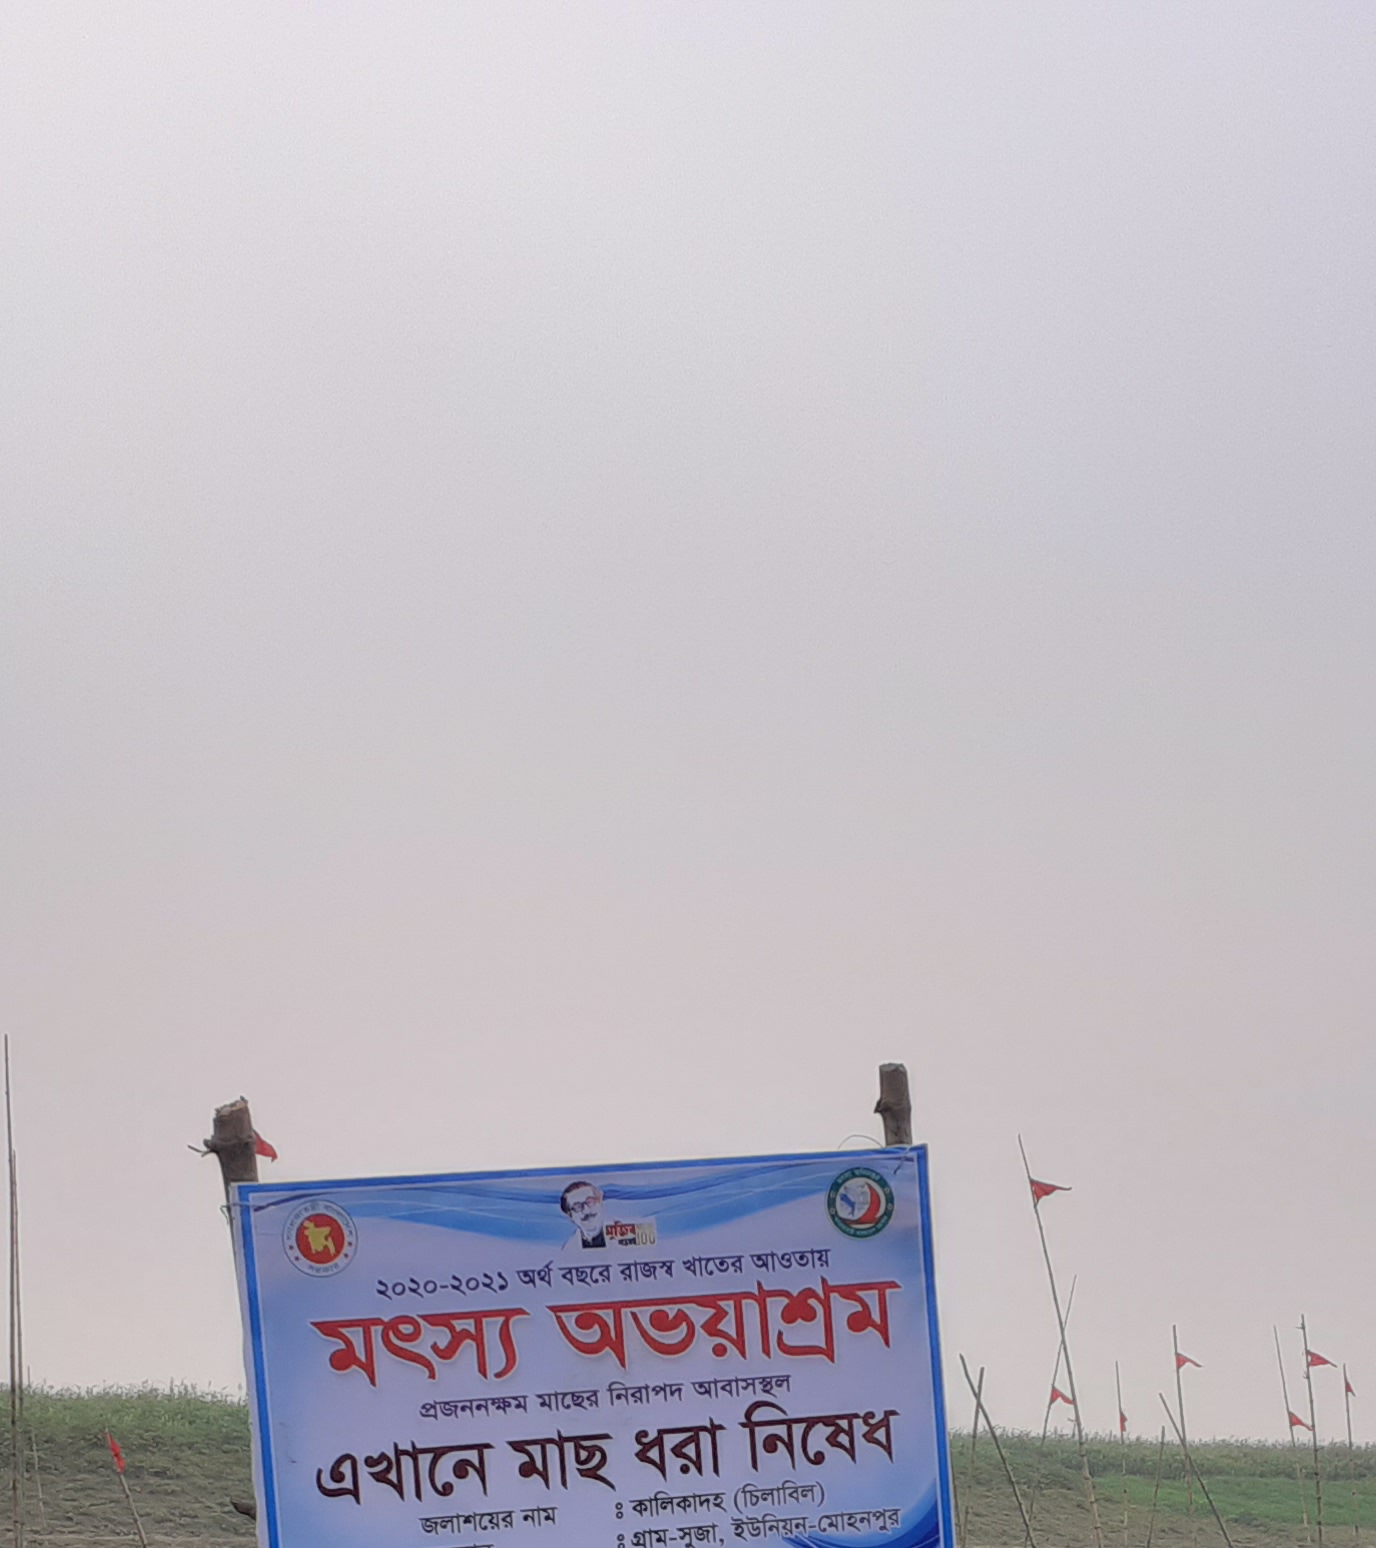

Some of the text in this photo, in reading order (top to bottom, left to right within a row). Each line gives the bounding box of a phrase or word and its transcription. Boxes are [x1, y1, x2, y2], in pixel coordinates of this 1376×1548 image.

[376, 1247, 832, 1301] ২০২০-২০২১ অর্থ বছরে রাজস্ব খাতের আওতায়
[309, 1276, 903, 1388] মৎস্য অভয়াশ্রম
[419, 1374, 792, 1421] প্রজননক্ষম মাছের নিরাপদ আবাসস্থল
[316, 1400, 901, 1505] এখানে মাছ ধরা নিষেধ
[418, 1509, 515, 1535] জলাশয়ের
[520, 1505, 558, 1528] নাম
[629, 1490, 727, 1518] কালিকাদহ
[733, 1480, 825, 1514] (চিলাবিল)
